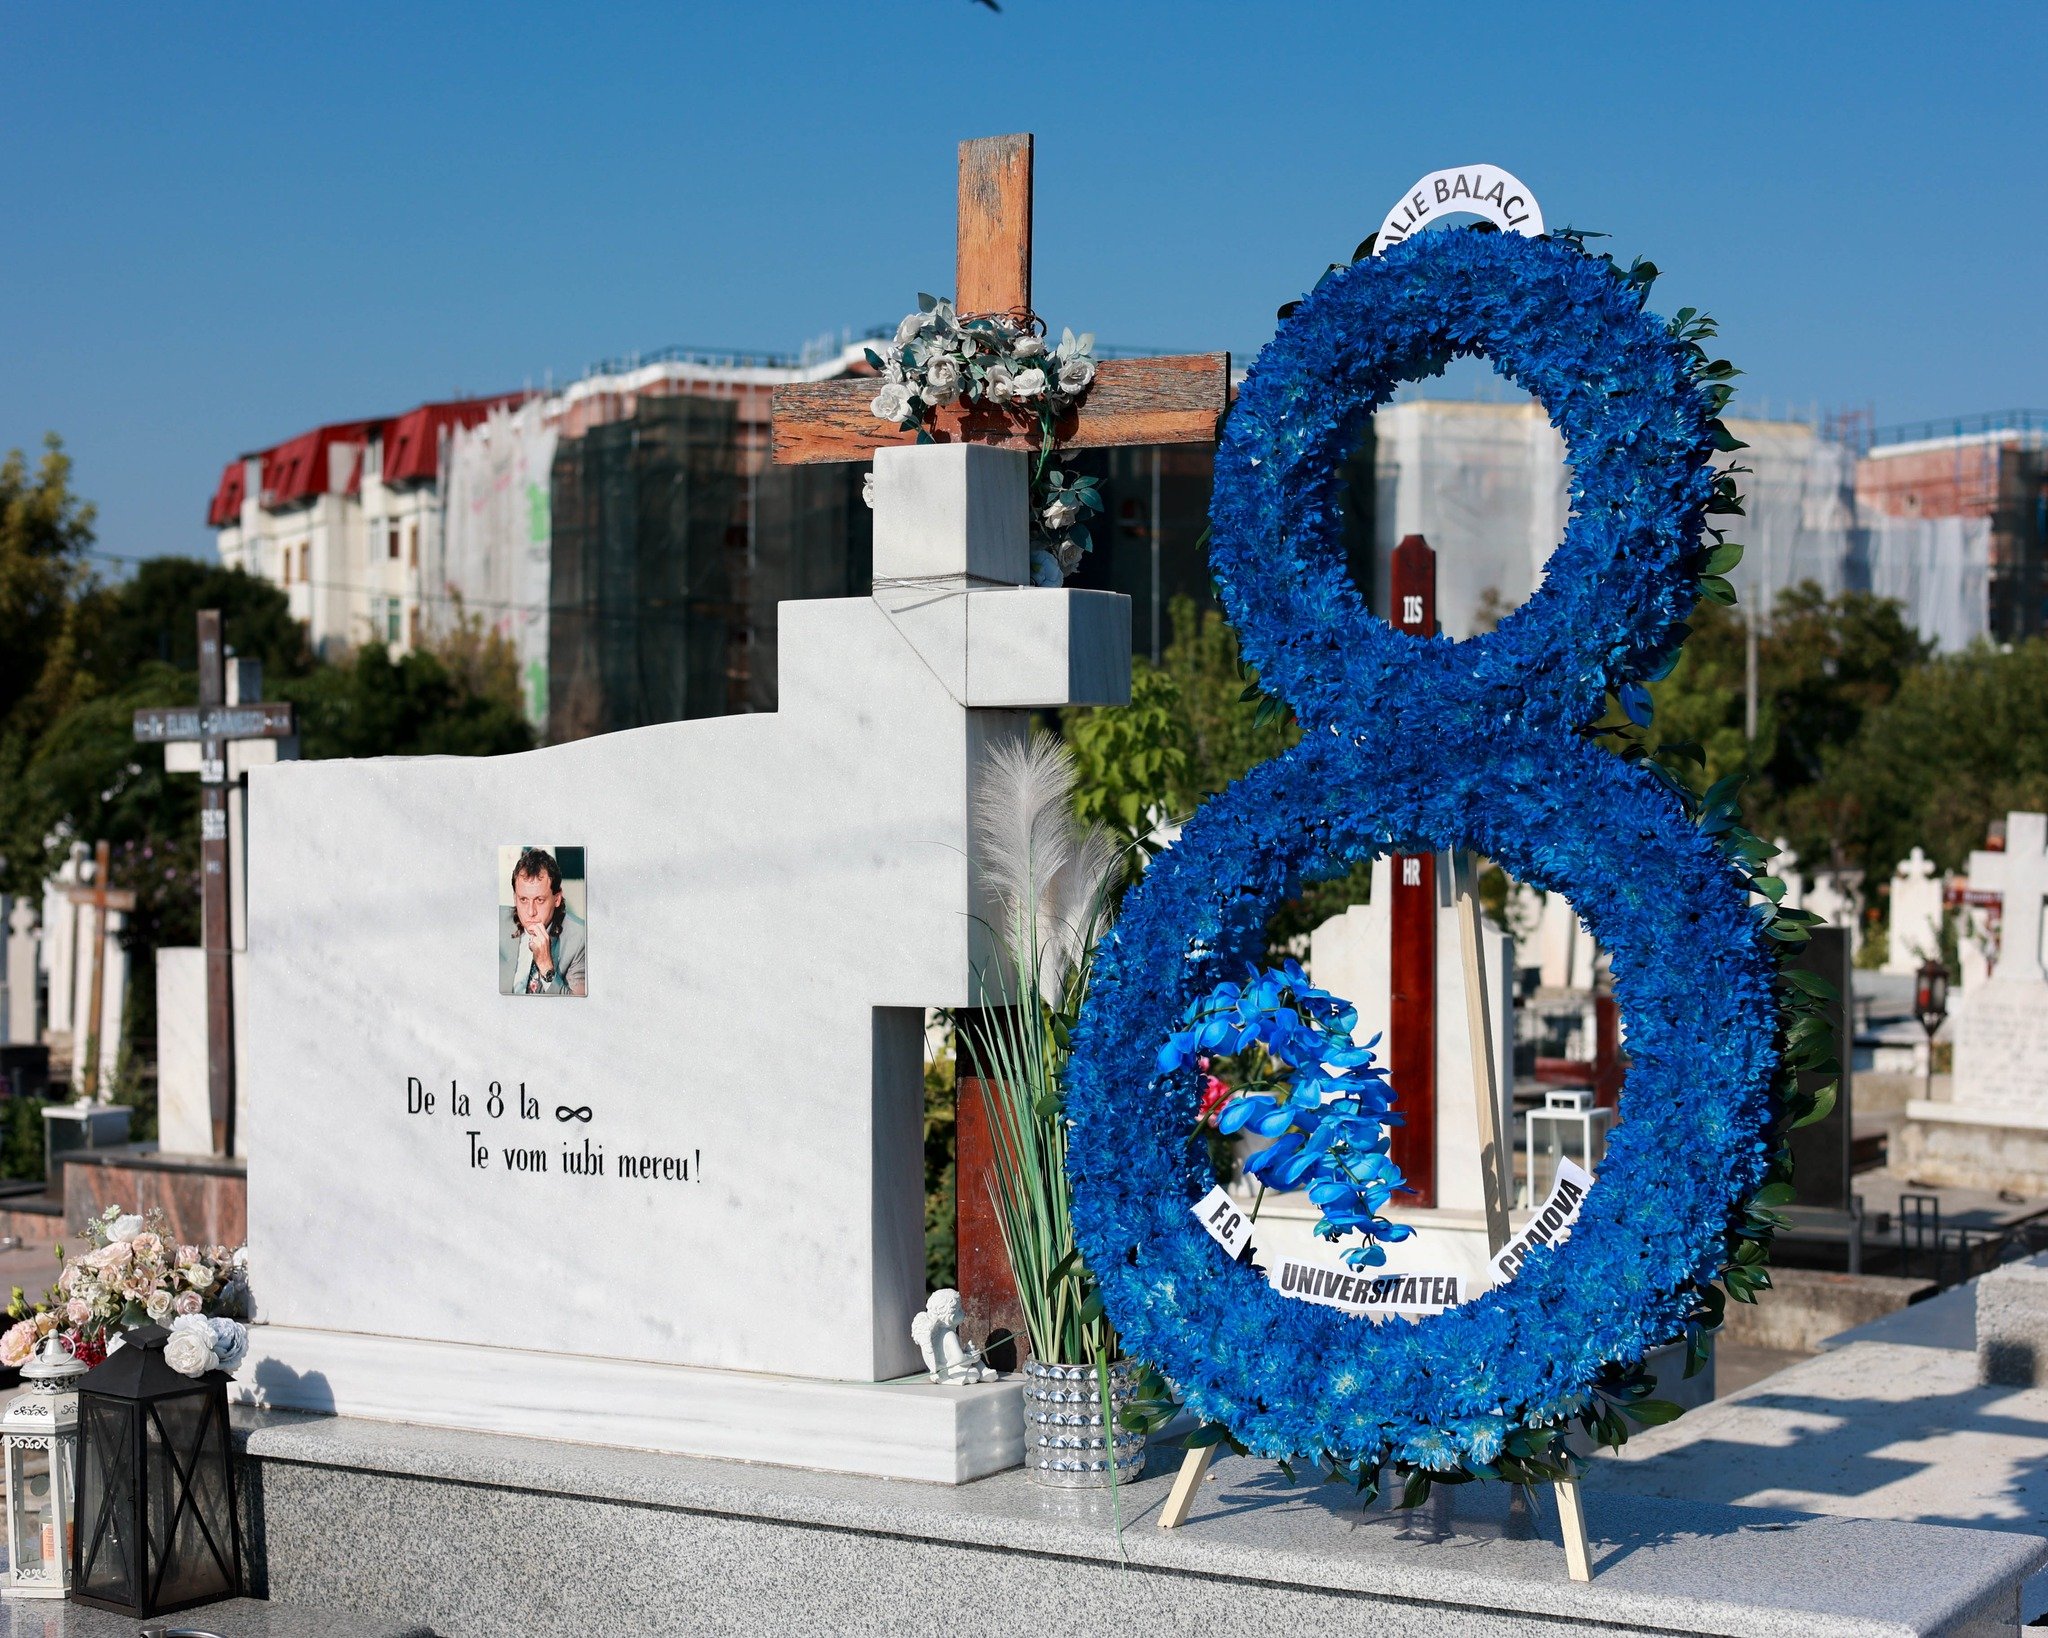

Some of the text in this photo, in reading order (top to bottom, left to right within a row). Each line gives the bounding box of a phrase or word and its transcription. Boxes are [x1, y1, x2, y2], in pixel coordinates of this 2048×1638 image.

[1384, 173, 1530, 241] ILIE BALACI
[407, 1077, 436, 1115] De
[451, 1079, 472, 1117] la
[486, 1081, 505, 1119] 8
[519, 1082, 541, 1121] la
[466, 1131, 701, 1184] Te vom iubi mereu!
[1208, 1201, 1240, 1245] F.C.
[1281, 1262, 1459, 1305] UNIVERSITATEA
